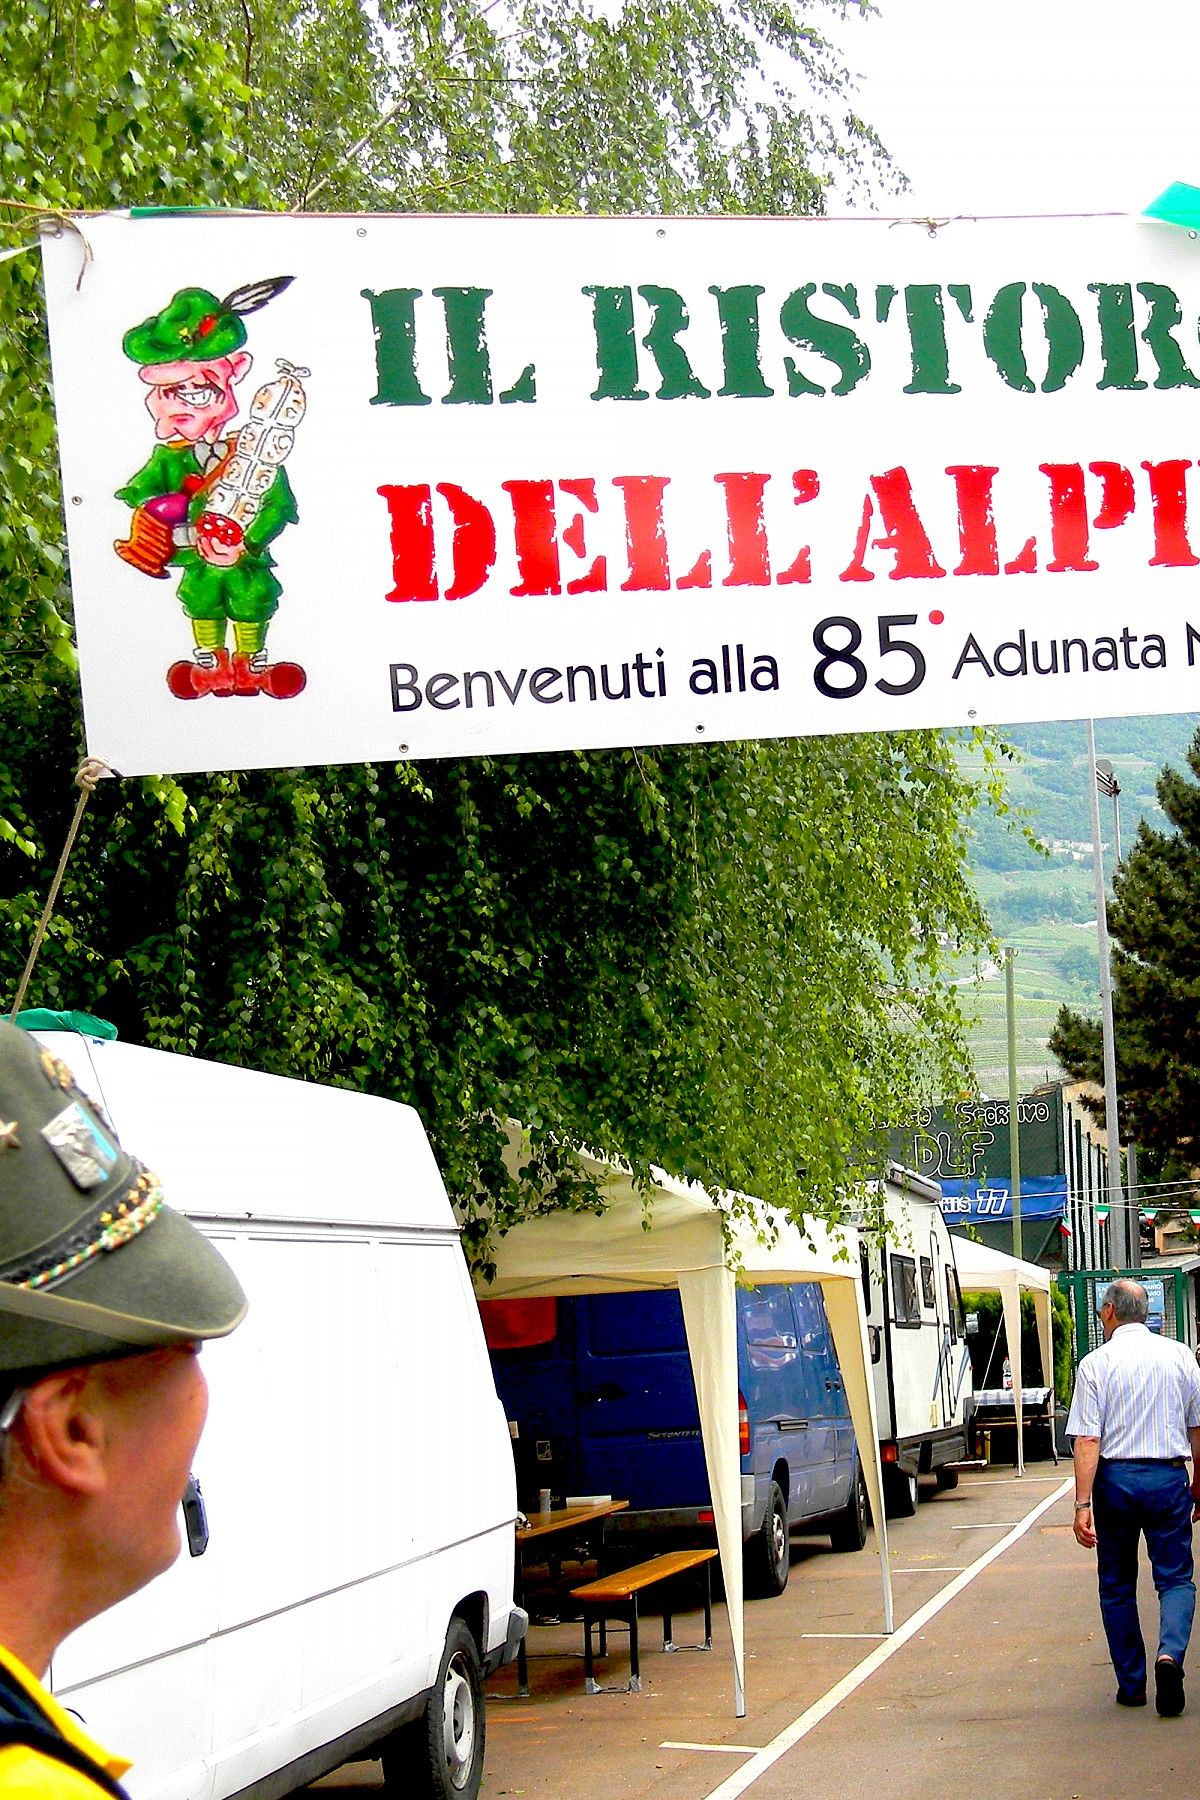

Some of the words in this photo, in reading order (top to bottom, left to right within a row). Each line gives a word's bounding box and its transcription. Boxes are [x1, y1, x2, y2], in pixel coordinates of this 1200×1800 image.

[361, 287, 537, 404] IL
[390, 651, 667, 712] Benvenuti
[688, 644, 780, 696] alla
[951, 630, 1167, 680] Adunata
[976, 1188, 1009, 1215] 77
